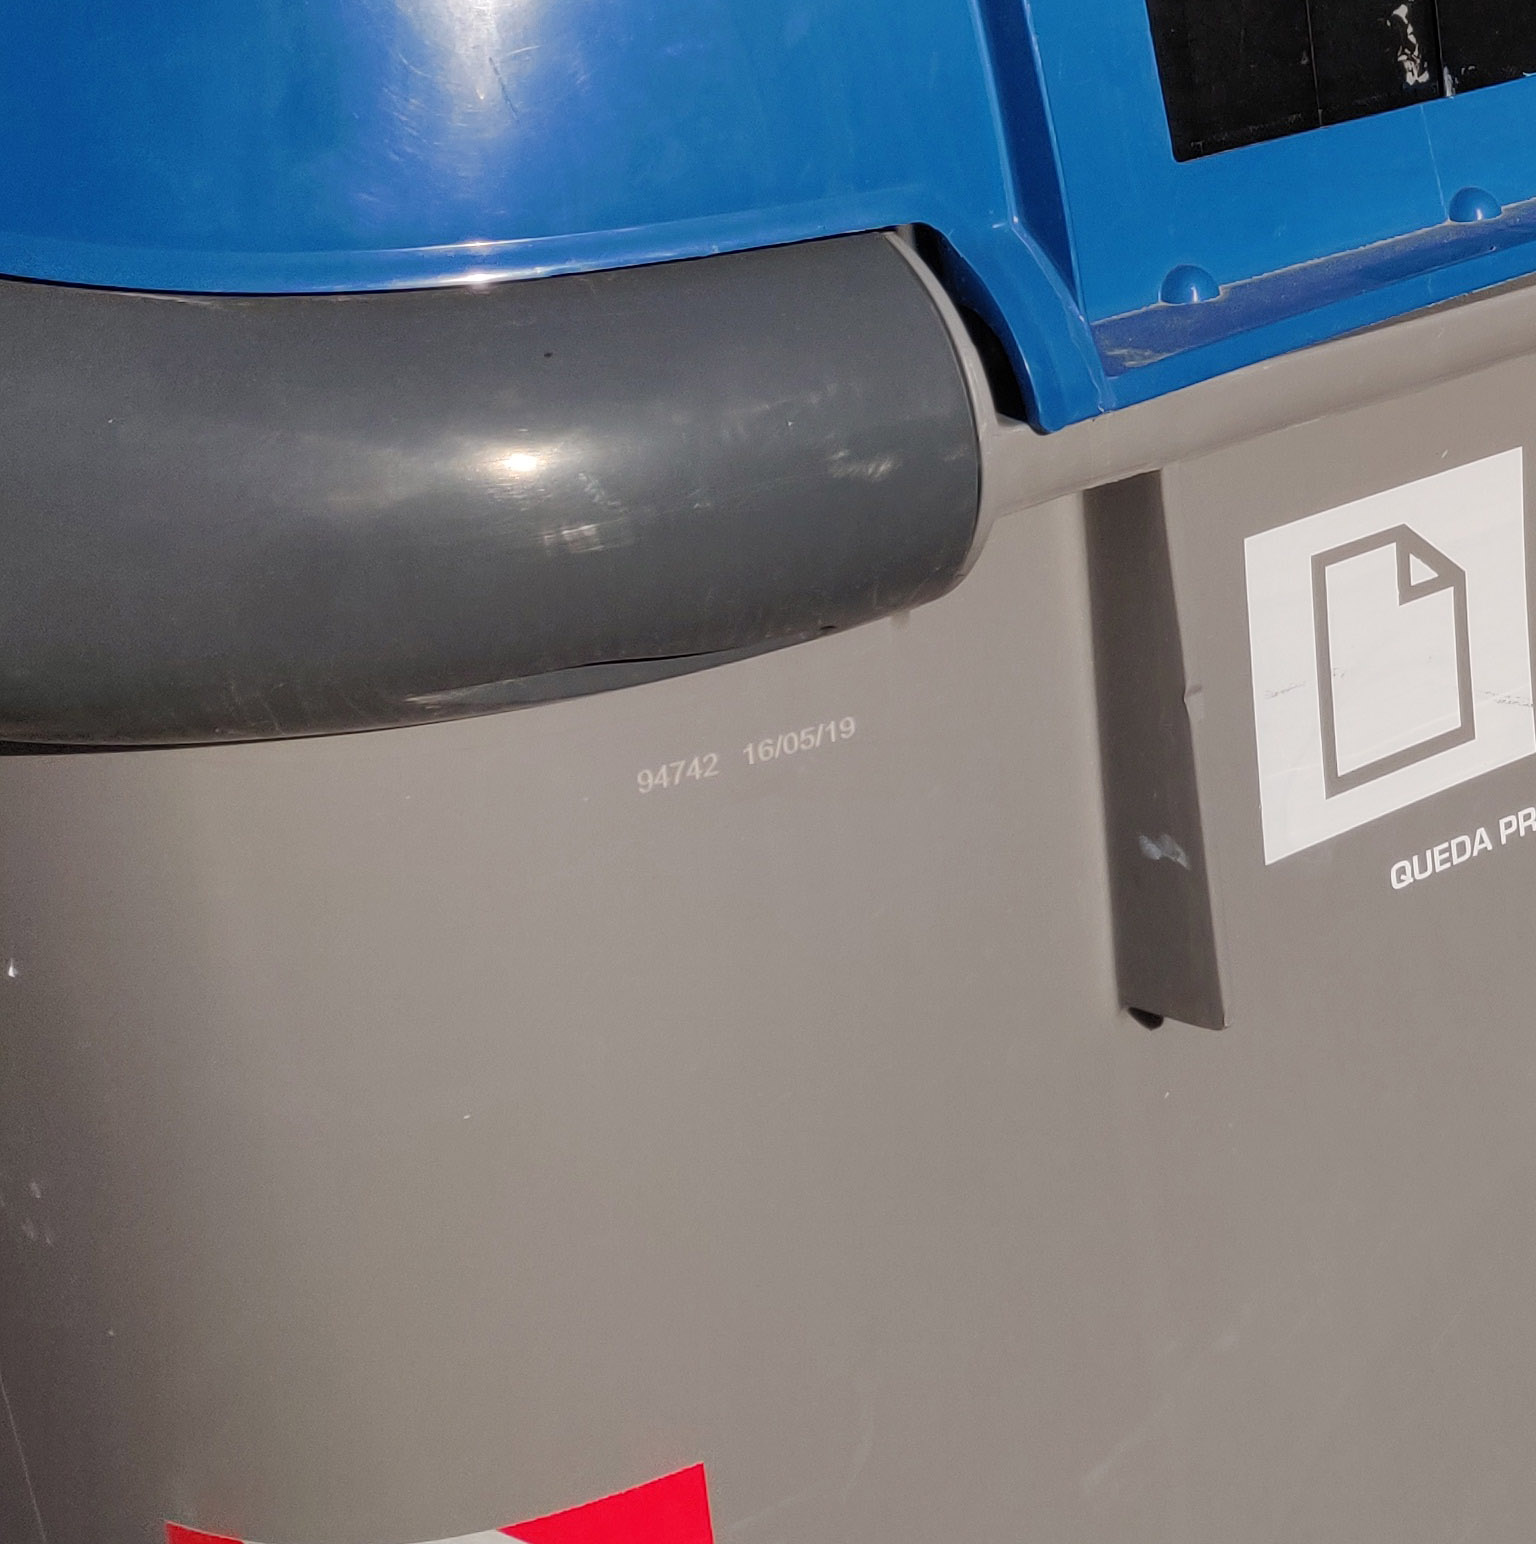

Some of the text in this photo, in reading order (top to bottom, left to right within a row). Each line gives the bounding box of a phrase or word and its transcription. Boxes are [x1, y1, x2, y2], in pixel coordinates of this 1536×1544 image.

[637, 716, 856, 794] 94742 16/05/19
[1390, 826, 1494, 890] QUEDA
